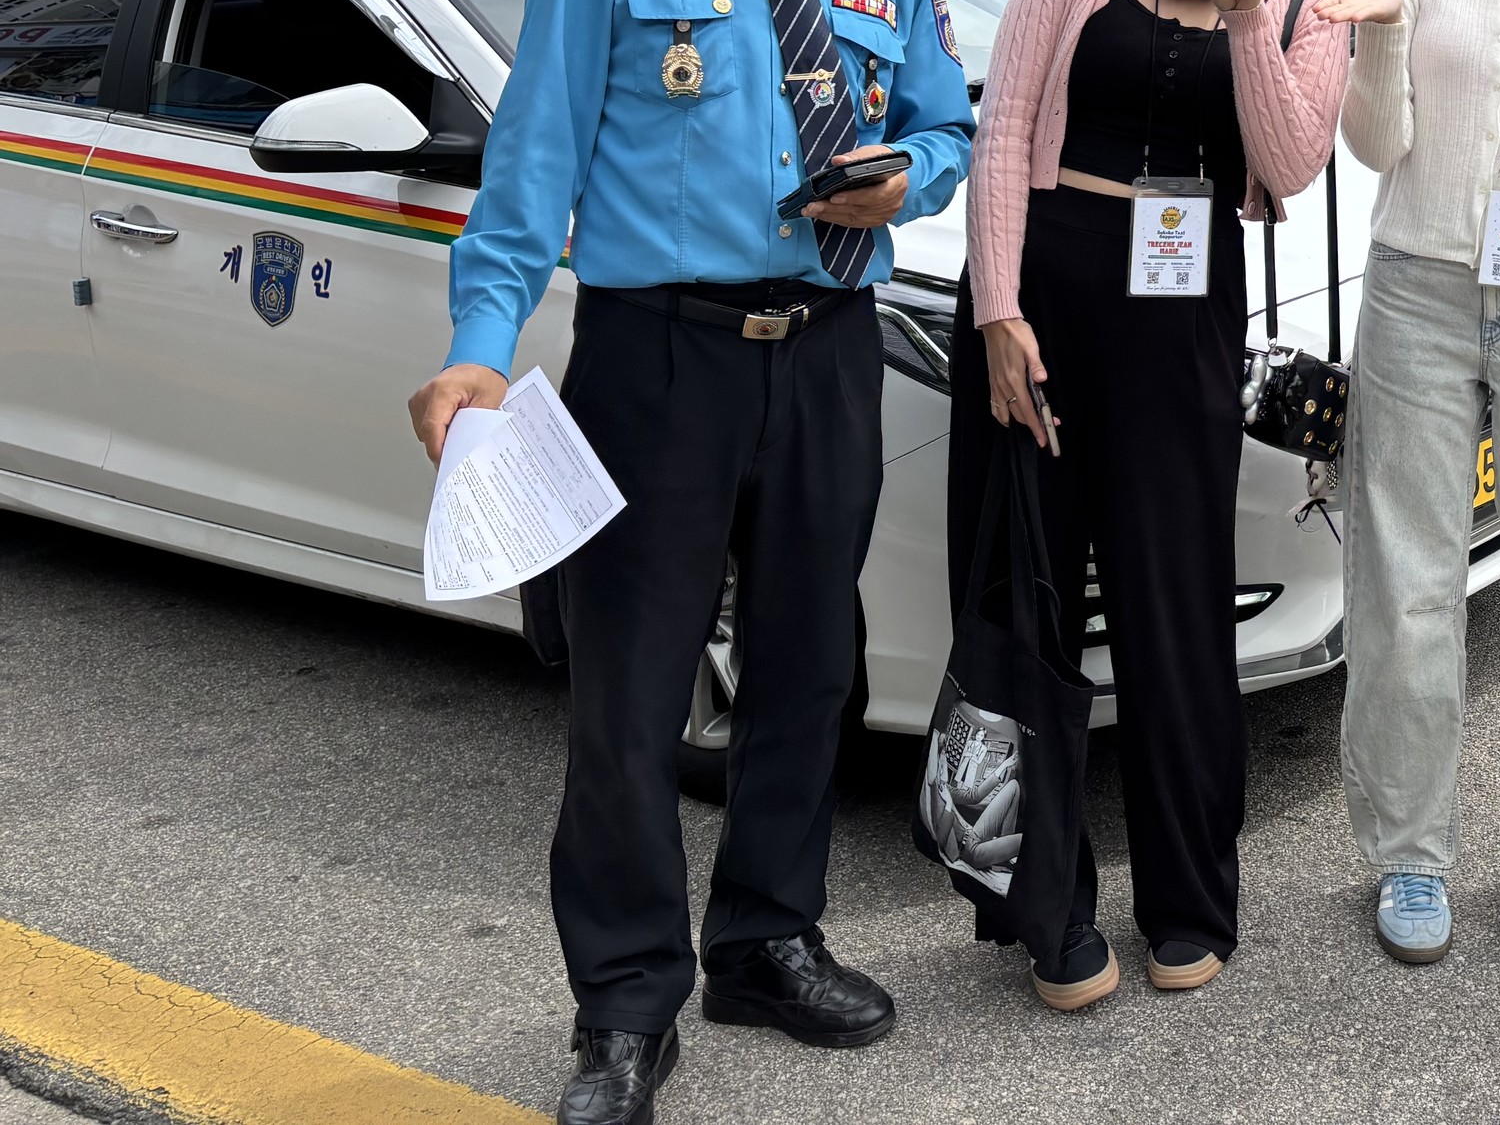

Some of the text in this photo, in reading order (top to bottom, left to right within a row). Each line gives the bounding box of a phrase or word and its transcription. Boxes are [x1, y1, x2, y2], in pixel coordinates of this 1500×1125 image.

[256, 236, 300, 257] 모범운전자
[262, 251, 293, 264] BEST DRIVER
[219, 245, 333, 299] 개 인
